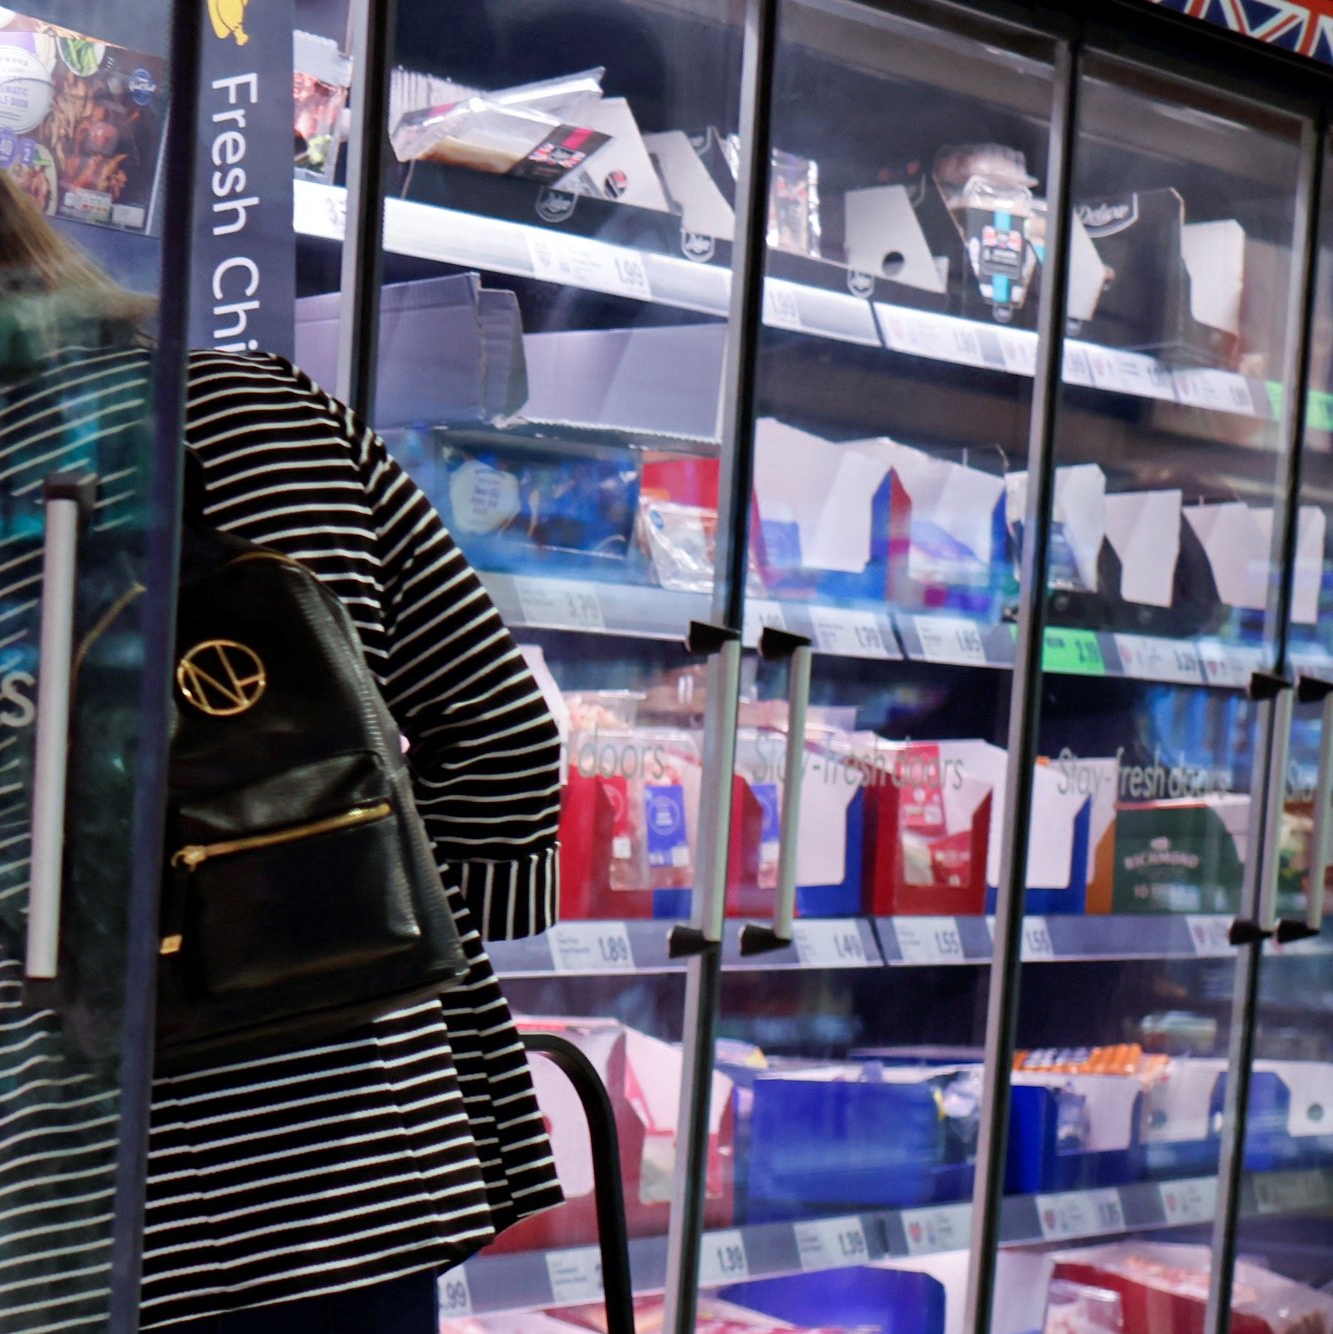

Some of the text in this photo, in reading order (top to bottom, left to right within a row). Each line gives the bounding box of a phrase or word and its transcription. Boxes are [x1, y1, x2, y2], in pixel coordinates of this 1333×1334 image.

[212, 73, 260, 351] Fresh Chi
[578, 722, 667, 781] doors
